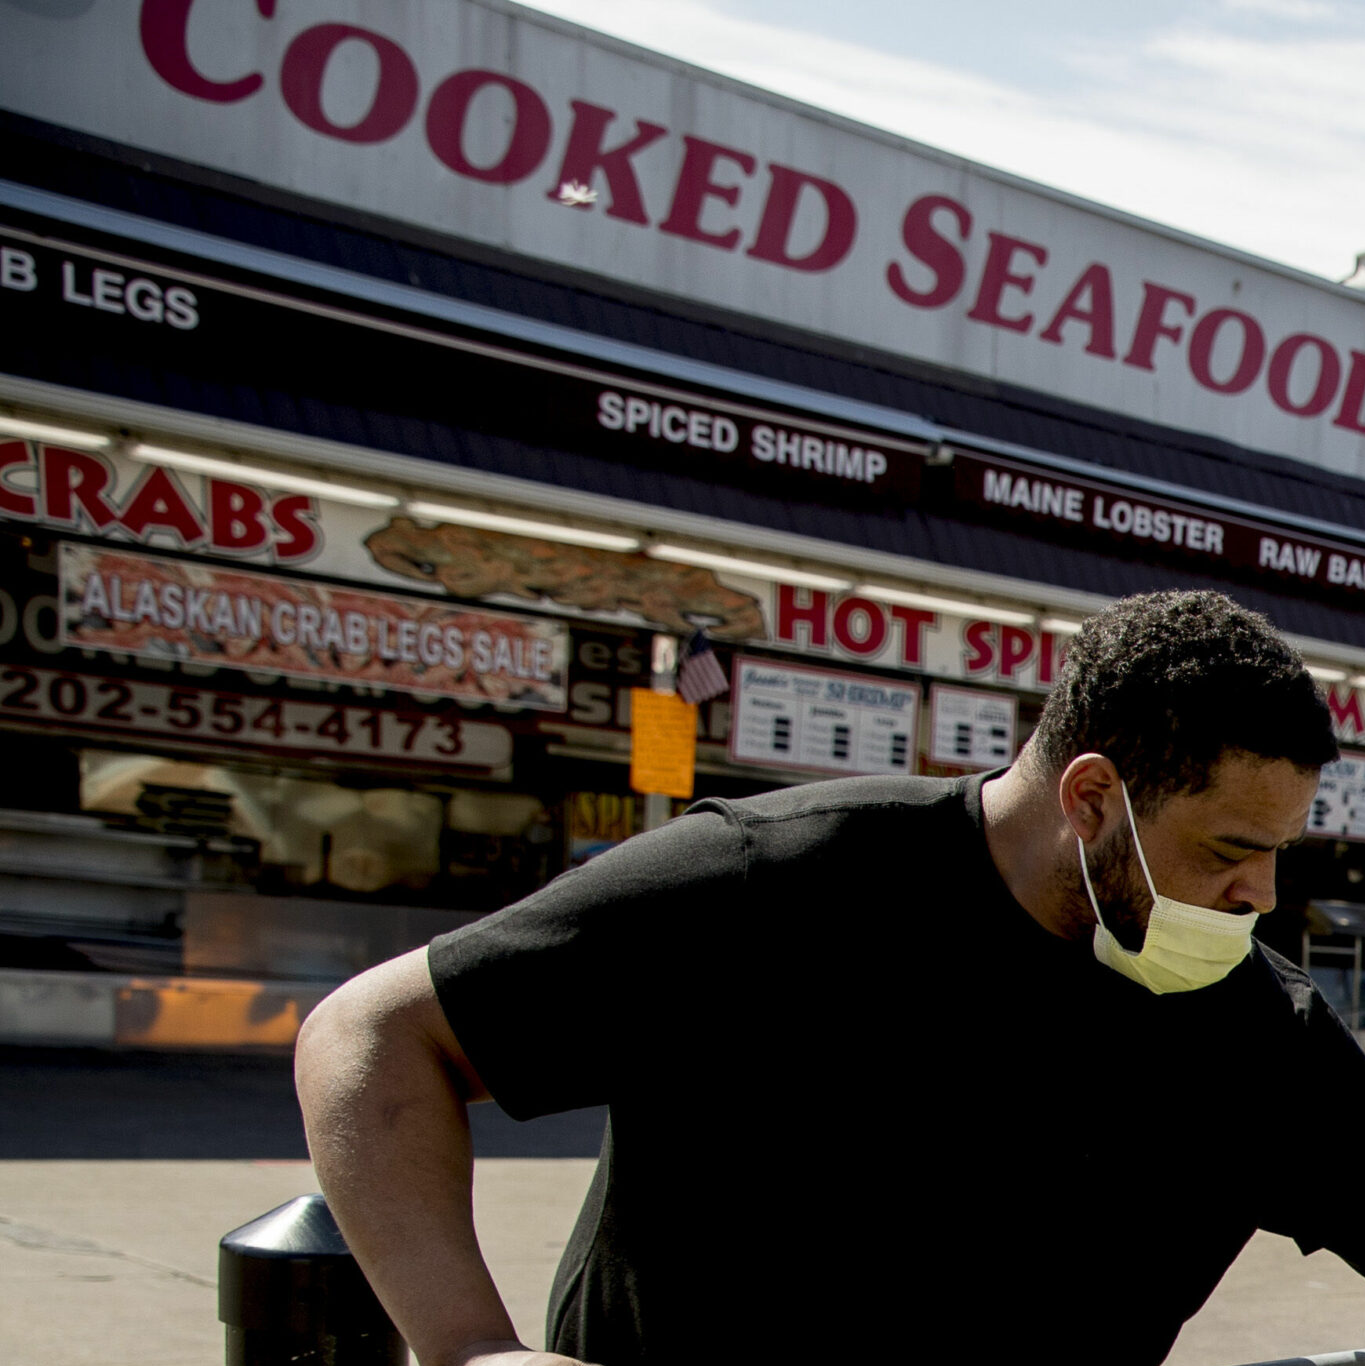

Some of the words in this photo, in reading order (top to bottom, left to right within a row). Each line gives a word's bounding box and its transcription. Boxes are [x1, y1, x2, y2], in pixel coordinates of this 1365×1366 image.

[138, 0, 858, 273] COOKED
[62, 261, 199, 330] LEGS
[598, 392, 739, 453] SPICED
[751, 426, 888, 484] SHRIMP
[0, 441, 321, 562] CRABS
[983, 471, 1084, 523] MAINE
[1093, 496, 1224, 556] LOBSTER
[1258, 536, 1321, 579] RAW
[81, 571, 262, 641] ALASKAN
[271, 601, 369, 656] CRAB
[376, 619, 465, 670] LEGS
[471, 628, 552, 682] SALE
[776, 583, 938, 667] HOT
[0, 669, 466, 756] 202-554-4173
